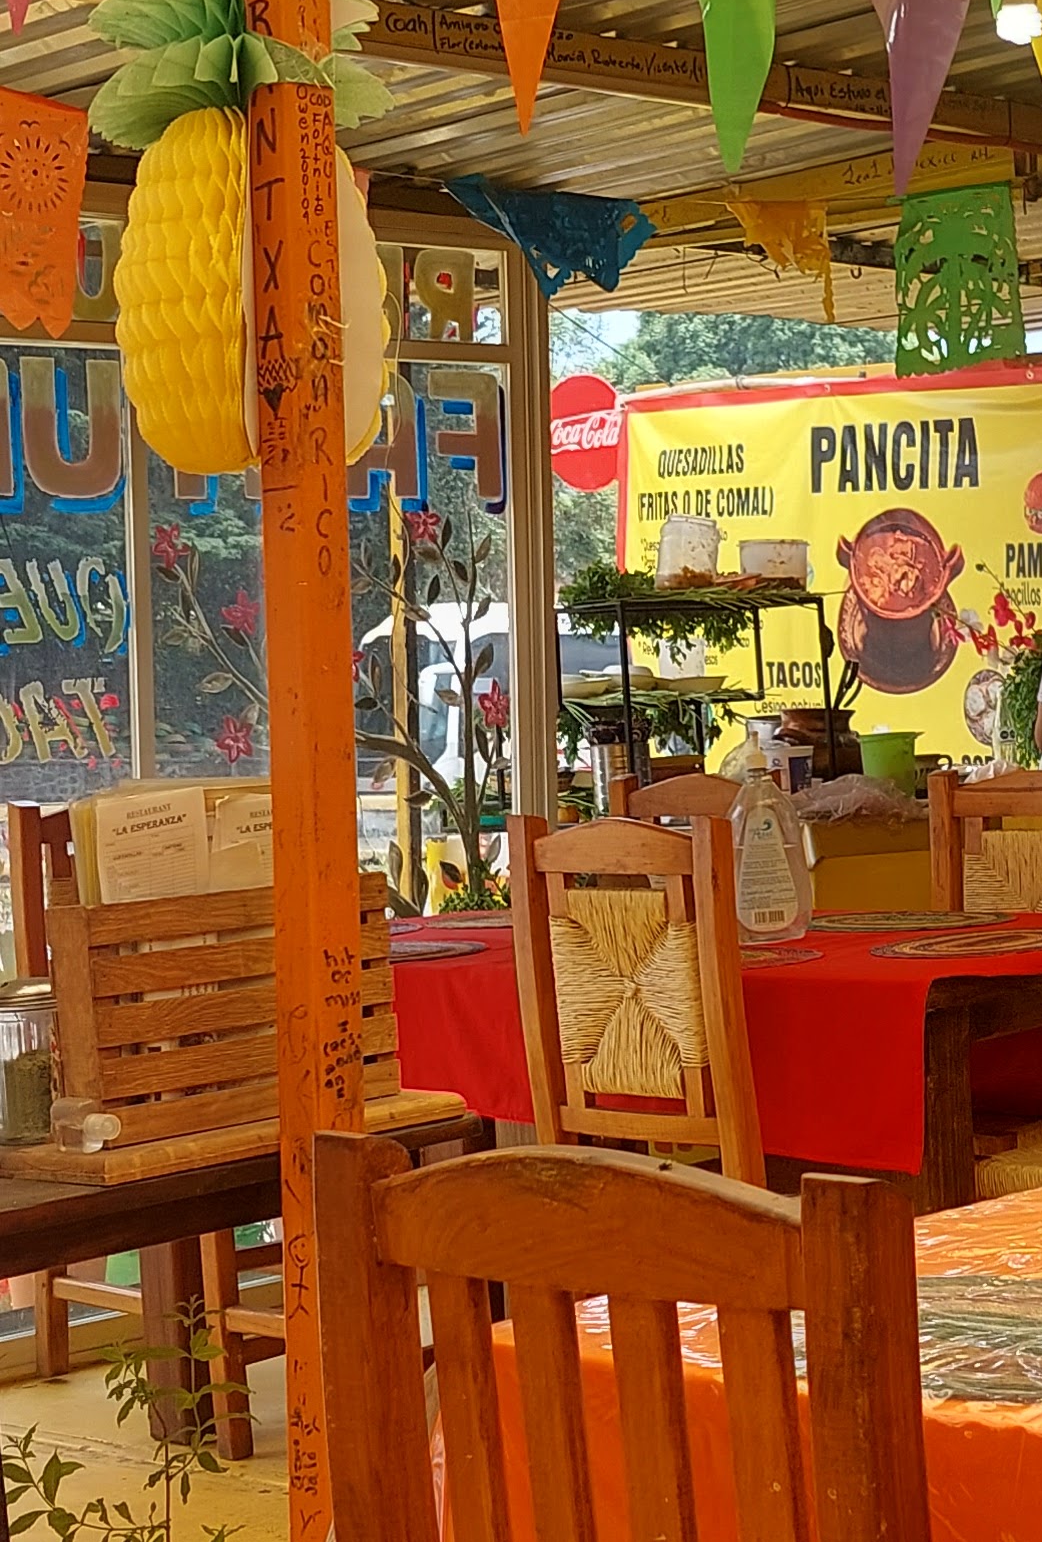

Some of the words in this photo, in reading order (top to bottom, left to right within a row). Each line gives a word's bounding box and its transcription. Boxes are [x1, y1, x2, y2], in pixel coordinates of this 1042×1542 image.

[657, 443, 745, 479] QUESADILLAS
[810, 417, 980, 494] PANCITA
[695, 488, 712, 518] DE
[716, 485, 775, 519] COMAL)
[766, 660, 822, 689] TACOS
[126, 802, 172, 820] RESTAURANT
